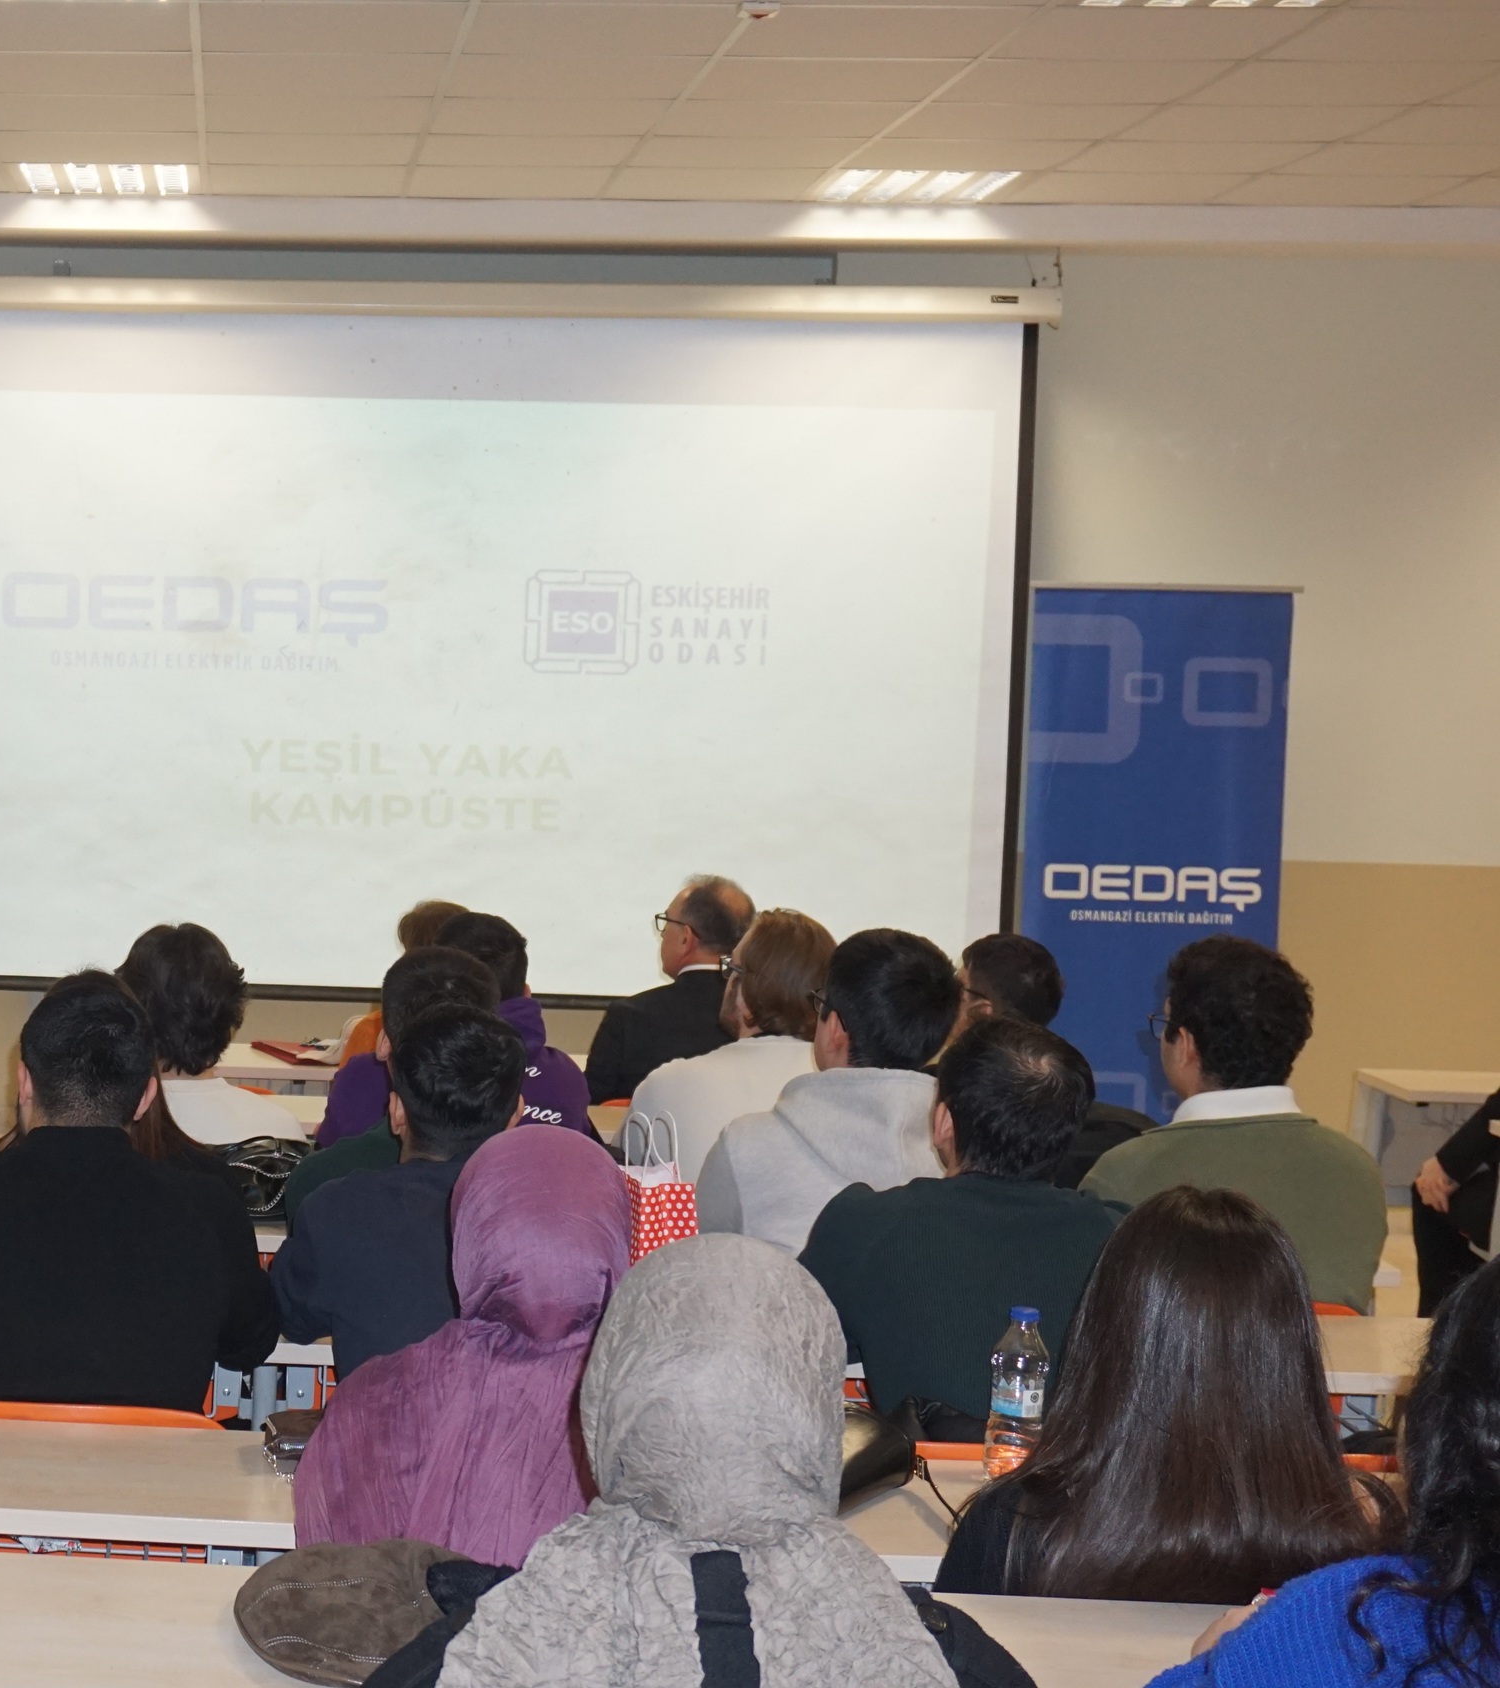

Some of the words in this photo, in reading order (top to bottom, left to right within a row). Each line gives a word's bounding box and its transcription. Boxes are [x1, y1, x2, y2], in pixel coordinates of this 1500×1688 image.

[2, 572, 389, 648] OEDAŞ
[650, 580, 770, 614] ESKİŞEHİR
[551, 610, 615, 635] ESO
[649, 614, 768, 640] SANAYİ
[50, 648, 159, 669] OSMANGAZİ
[165, 650, 253, 671] ELEKTRİK
[648, 642, 767, 666] ODASI
[240, 732, 397, 783] YEŞİL
[418, 742, 574, 781] YAKA
[250, 788, 560, 833] KAMPÜSTE
[1043, 863, 1262, 912] OEDAŞ
[1070, 908, 1132, 922] OSMANGAZİ
[1135, 910, 1185, 924] ELEKTRİK
[1188, 910, 1233, 925] DAĞITIM
